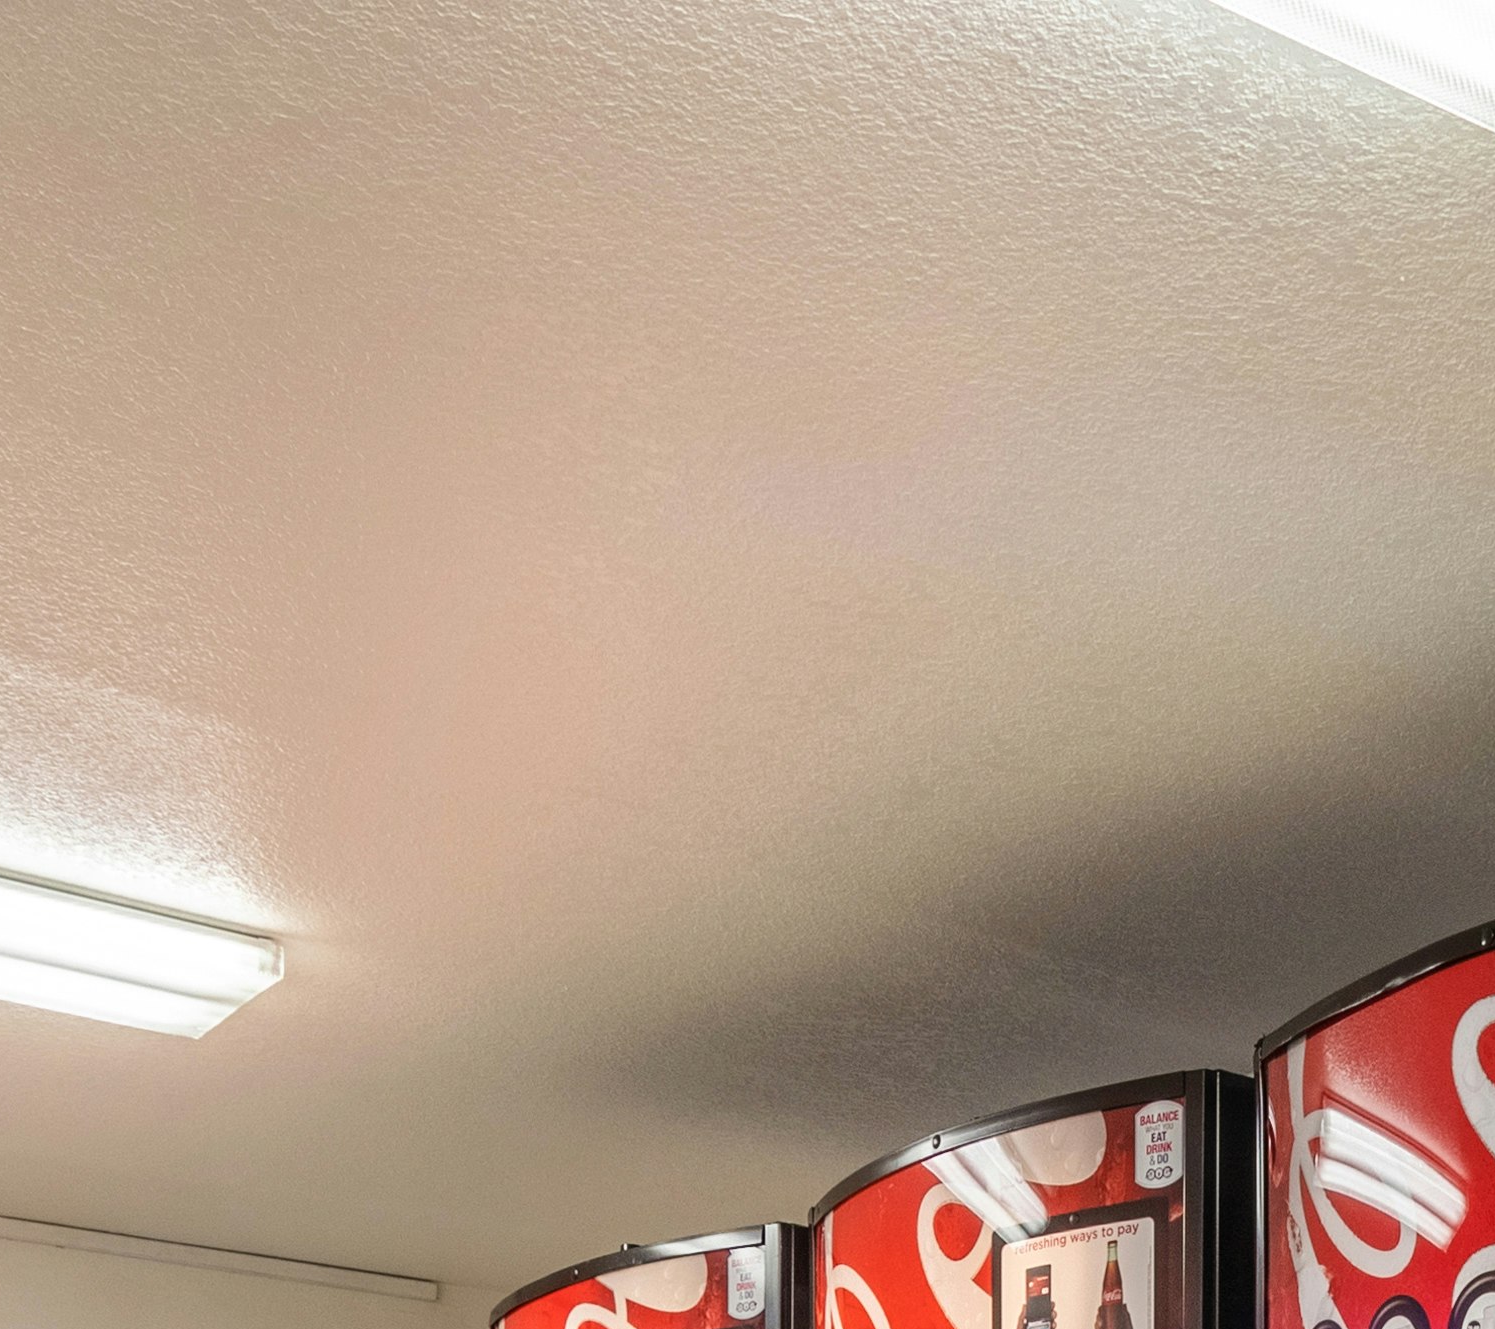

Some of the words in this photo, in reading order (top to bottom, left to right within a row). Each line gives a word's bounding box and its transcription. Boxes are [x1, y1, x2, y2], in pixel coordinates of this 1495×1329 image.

[1140, 1110, 1179, 1126] BALANCE
[1151, 1132, 1167, 1143] EAT
[1146, 1142, 1172, 1155] DRINK
[1157, 1153, 1169, 1163] DO
[1015, 1234, 1067, 1255] refreshing
[1070, 1229, 1098, 1244] ways
[1102, 1226, 1114, 1238] to
[1117, 1223, 1139, 1238] pay
